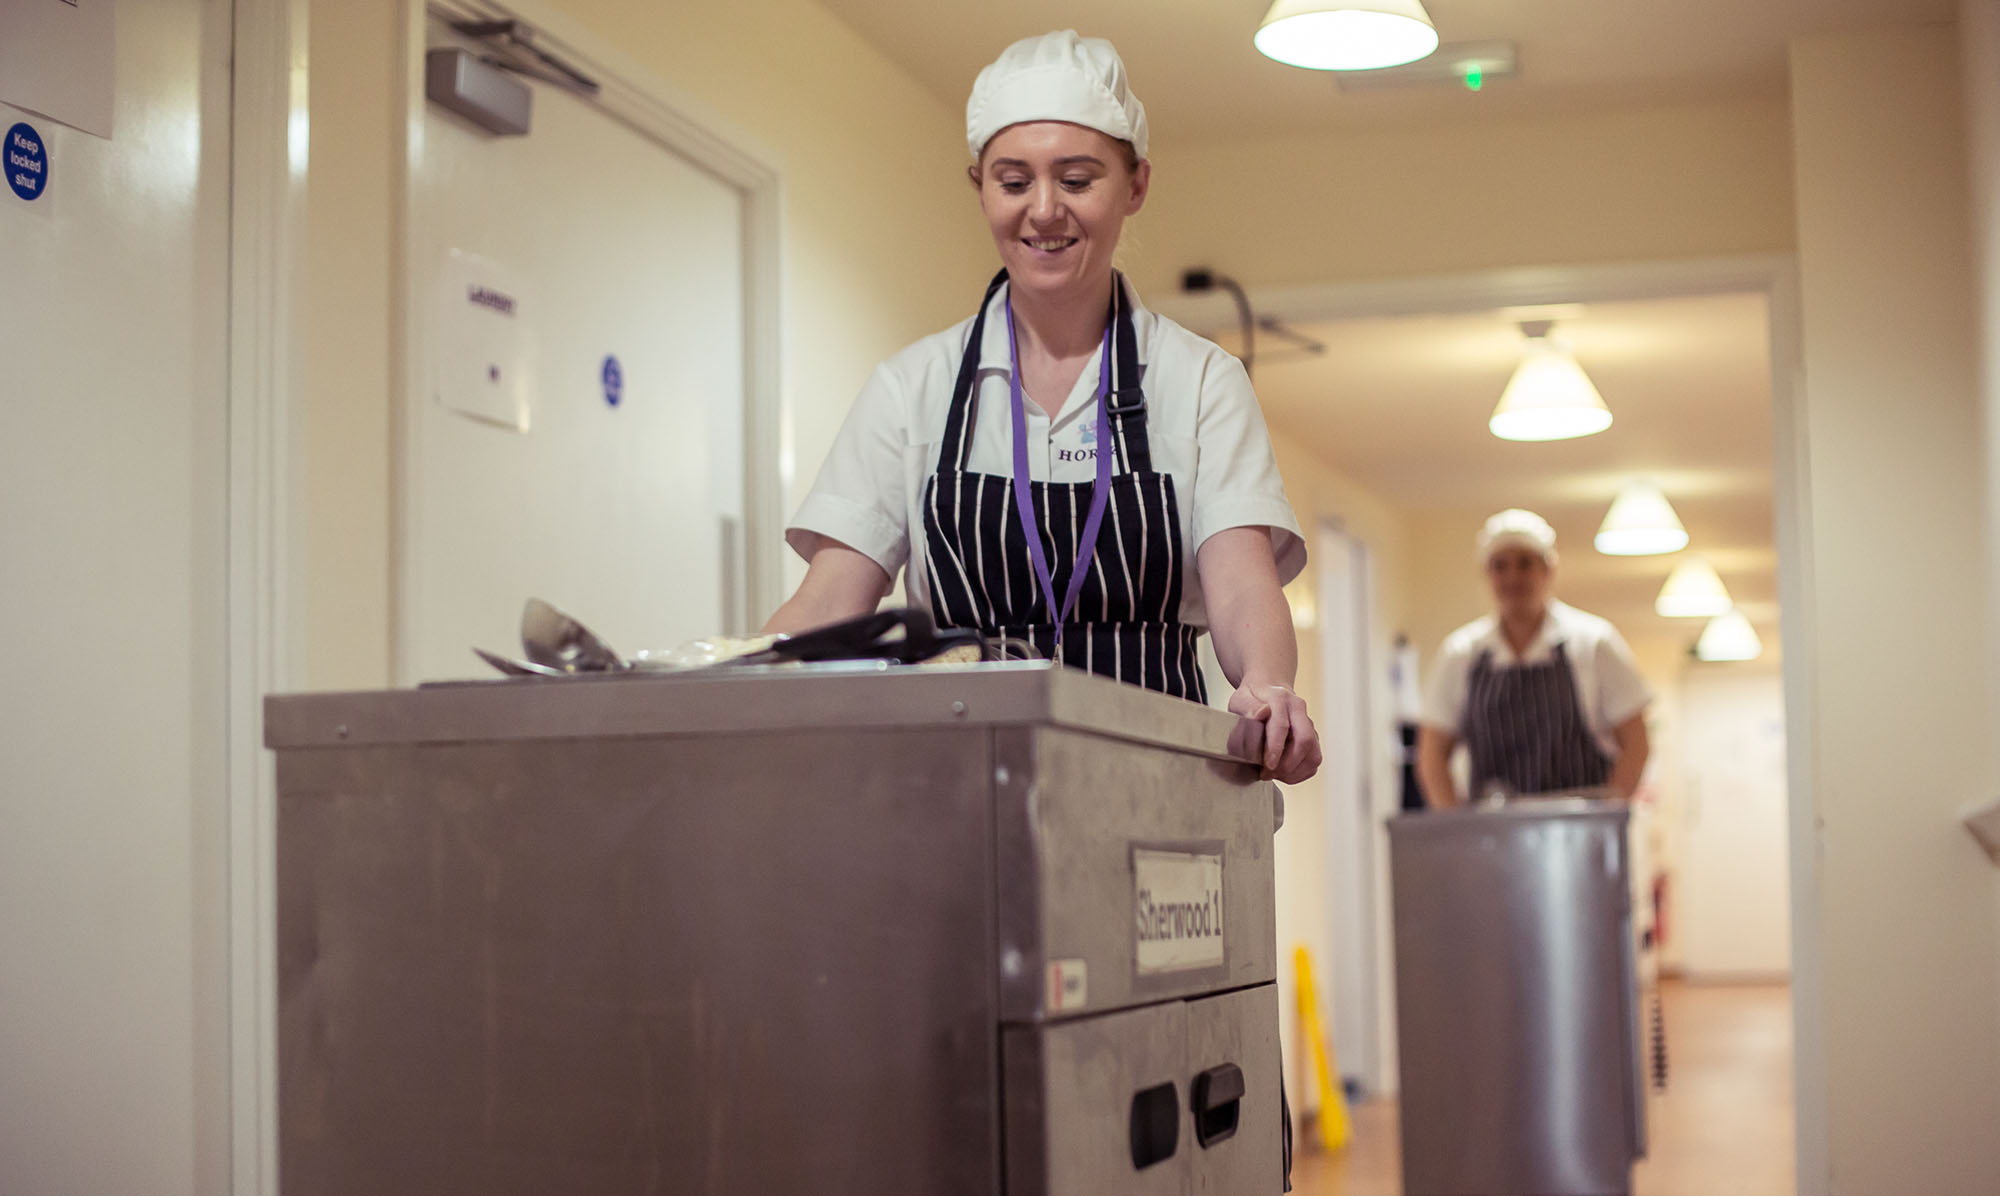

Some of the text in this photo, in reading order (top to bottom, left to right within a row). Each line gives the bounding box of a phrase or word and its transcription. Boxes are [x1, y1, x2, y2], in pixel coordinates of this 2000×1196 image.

[14, 133, 38, 155] Keep
[10, 151, 41, 173] locked
[15, 174, 36, 190] shut
[1138, 888, 1221, 940] Sherwood 1
